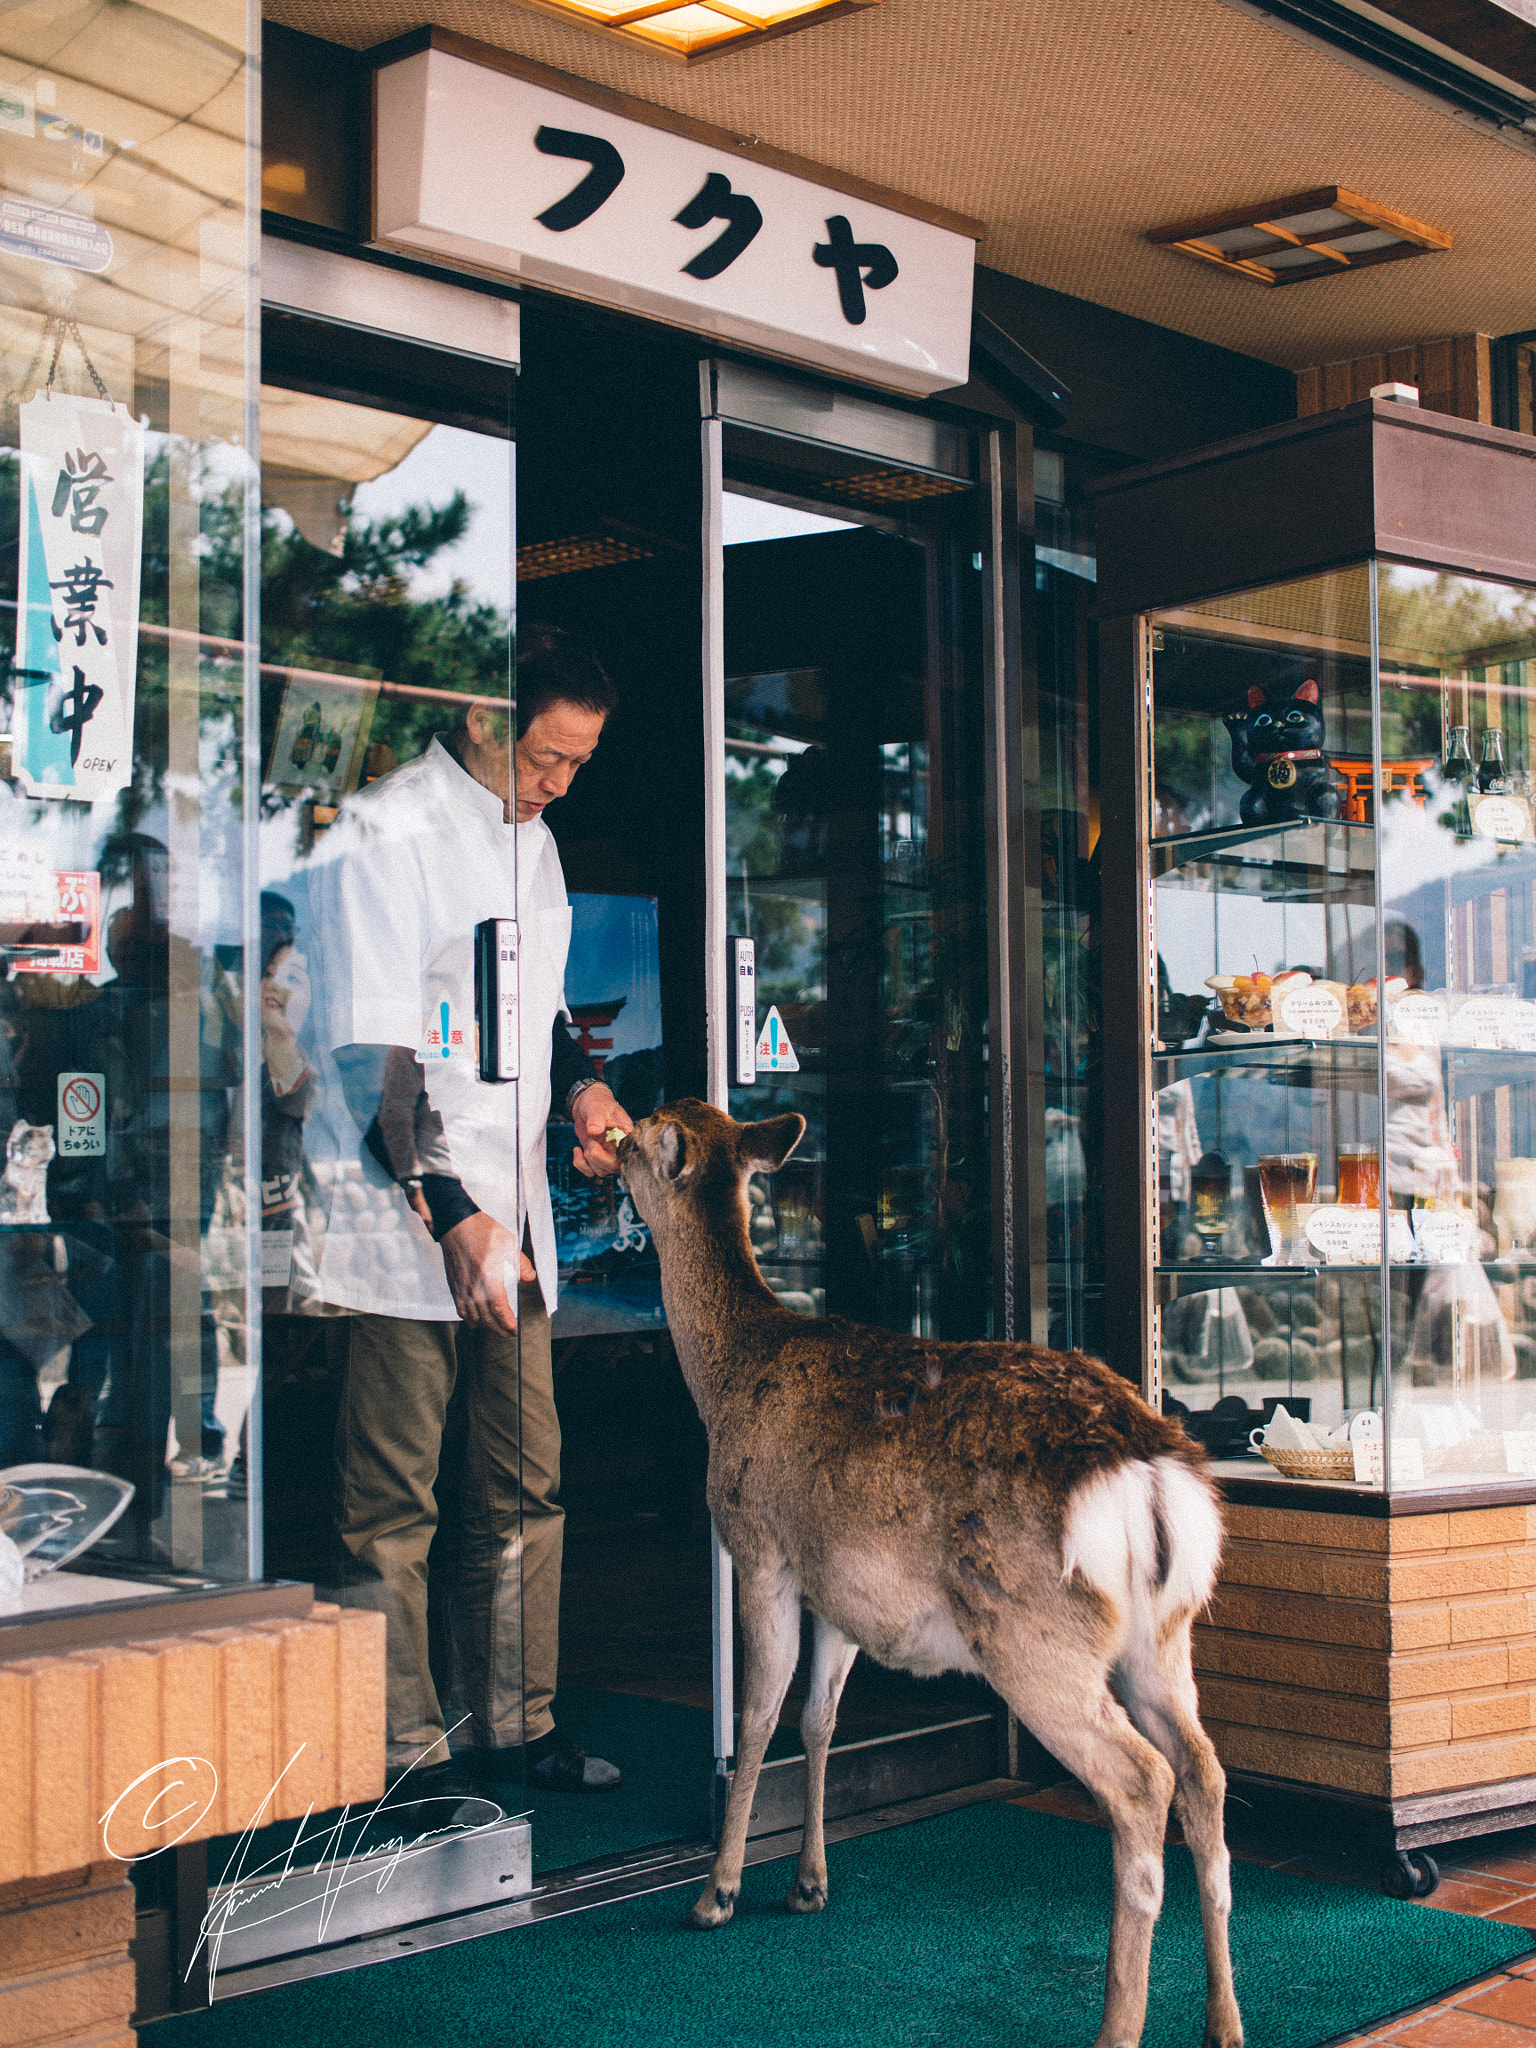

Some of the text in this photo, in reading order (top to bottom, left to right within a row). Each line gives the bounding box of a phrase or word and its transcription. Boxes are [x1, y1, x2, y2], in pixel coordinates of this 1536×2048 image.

[533, 124, 900, 326] フクヤ
[50, 446, 115, 769] 営業中
[83, 756, 118, 773] OPEN
[57, 875, 88, 913] ぶ
[501, 934, 517, 946] AUTO
[500, 950, 517, 962] 自動
[740, 950, 754, 962] AUTO
[740, 965, 754, 976] 自動
[501, 993, 517, 1005] PUSH
[740, 1005, 754, 1017] PUSH
[69, 1126, 96, 1137] ドアに
[63, 1140, 101, 1151] ちゅうい
[612, 1178, 647, 1253] 島
